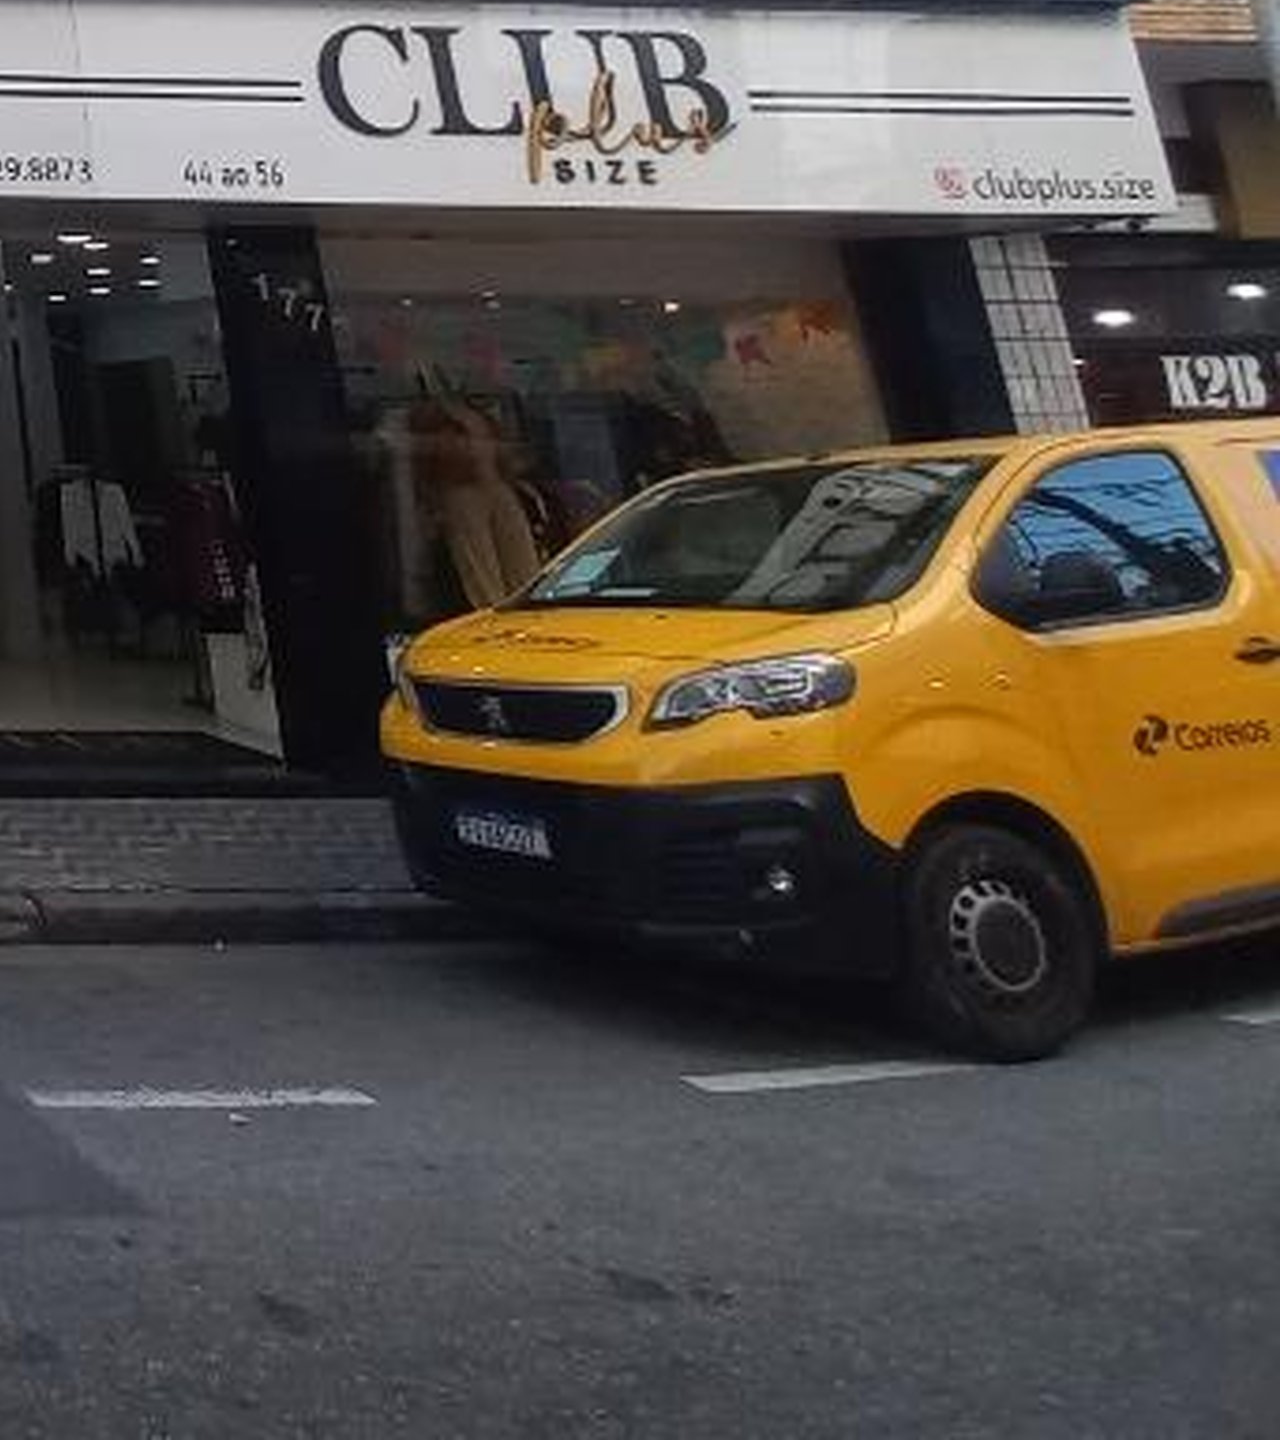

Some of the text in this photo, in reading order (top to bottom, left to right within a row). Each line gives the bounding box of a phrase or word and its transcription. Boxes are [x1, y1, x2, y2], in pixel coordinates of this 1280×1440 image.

[318, 24, 730, 137] CLUB
[526, 68, 738, 184] plus
[184, 160, 284, 187] 44 ao 56
[553, 160, 659, 185] SIZE
[972, 168, 1156, 207] clubplus.size
[251, 272, 324, 332] 177
[1160, 354, 1267, 410] K2B
[1175, 718, 1272, 751] Correios
